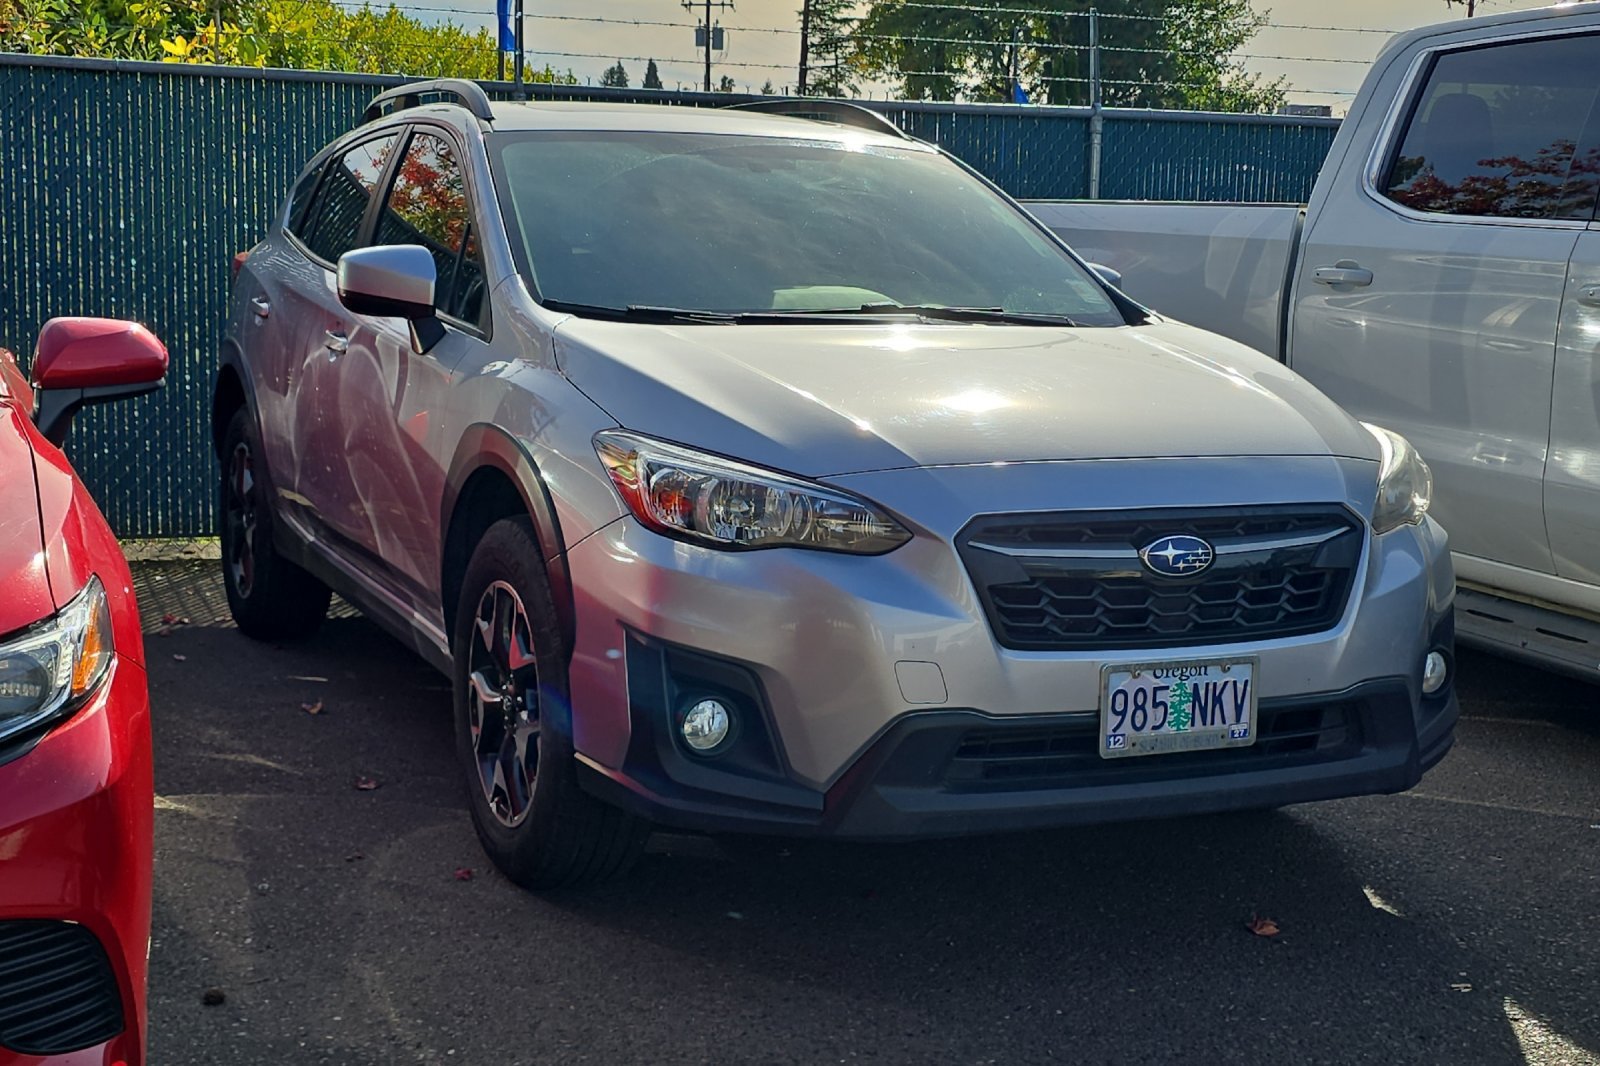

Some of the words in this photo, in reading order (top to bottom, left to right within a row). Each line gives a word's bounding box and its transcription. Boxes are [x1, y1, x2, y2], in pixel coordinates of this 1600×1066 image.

[1153, 665, 1208, 681] Oregon
[1111, 686, 1170, 733] 985
[1190, 679, 1249, 727] NKV
[1233, 730, 1245, 738] 27
[1108, 735, 1124, 749] 12
